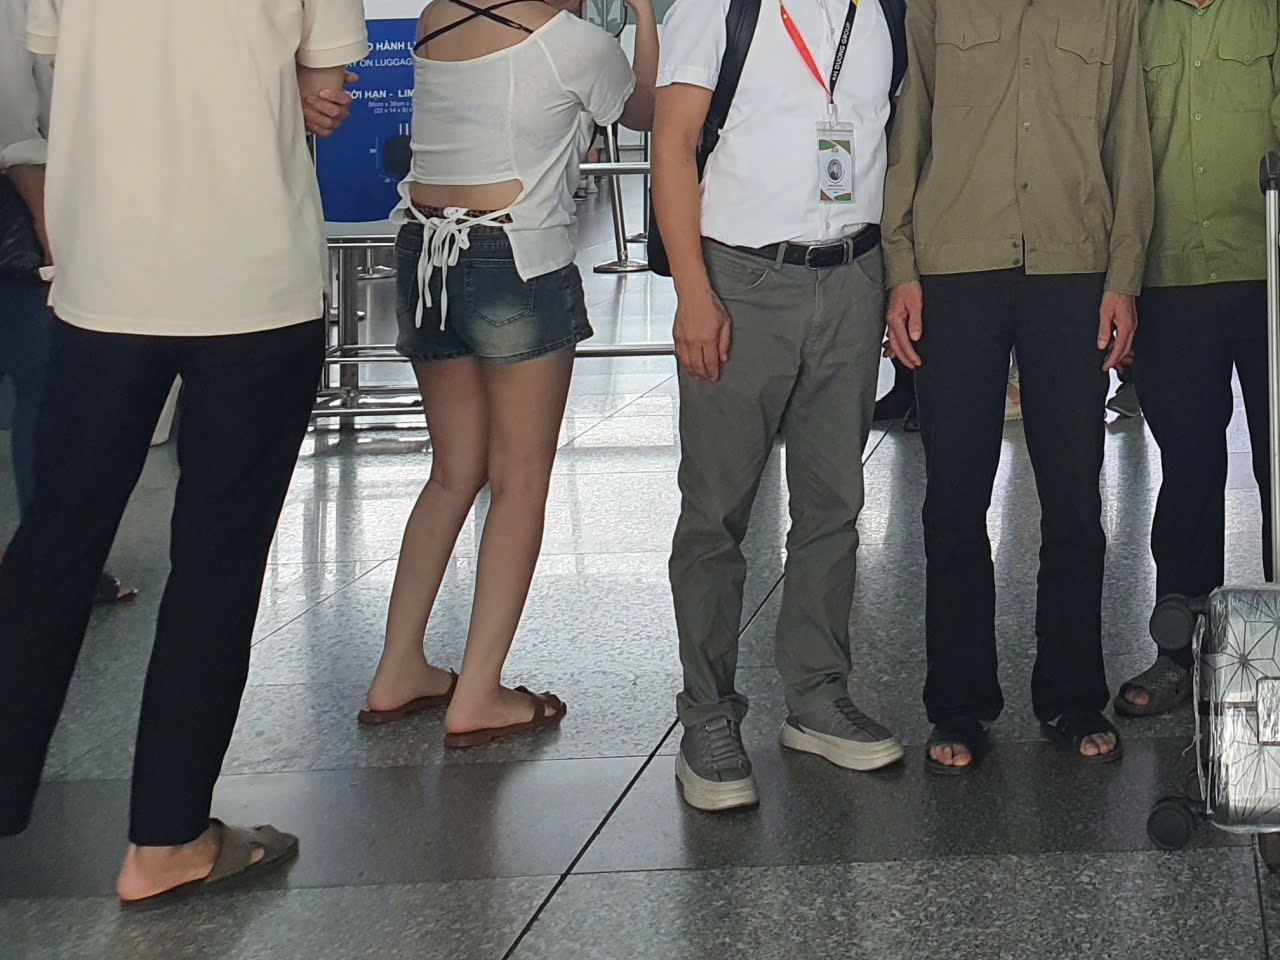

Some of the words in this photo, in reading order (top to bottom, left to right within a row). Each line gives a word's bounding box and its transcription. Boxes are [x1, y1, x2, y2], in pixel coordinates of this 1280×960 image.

[376, 39, 404, 51] HÀNH
[834, 45, 845, 69] DUONG
[841, 21, 850, 44] GROUP
[359, 59, 373, 67] ON
[375, 58, 414, 67] LUGGAG
[365, 89, 386, 100] HẠN
